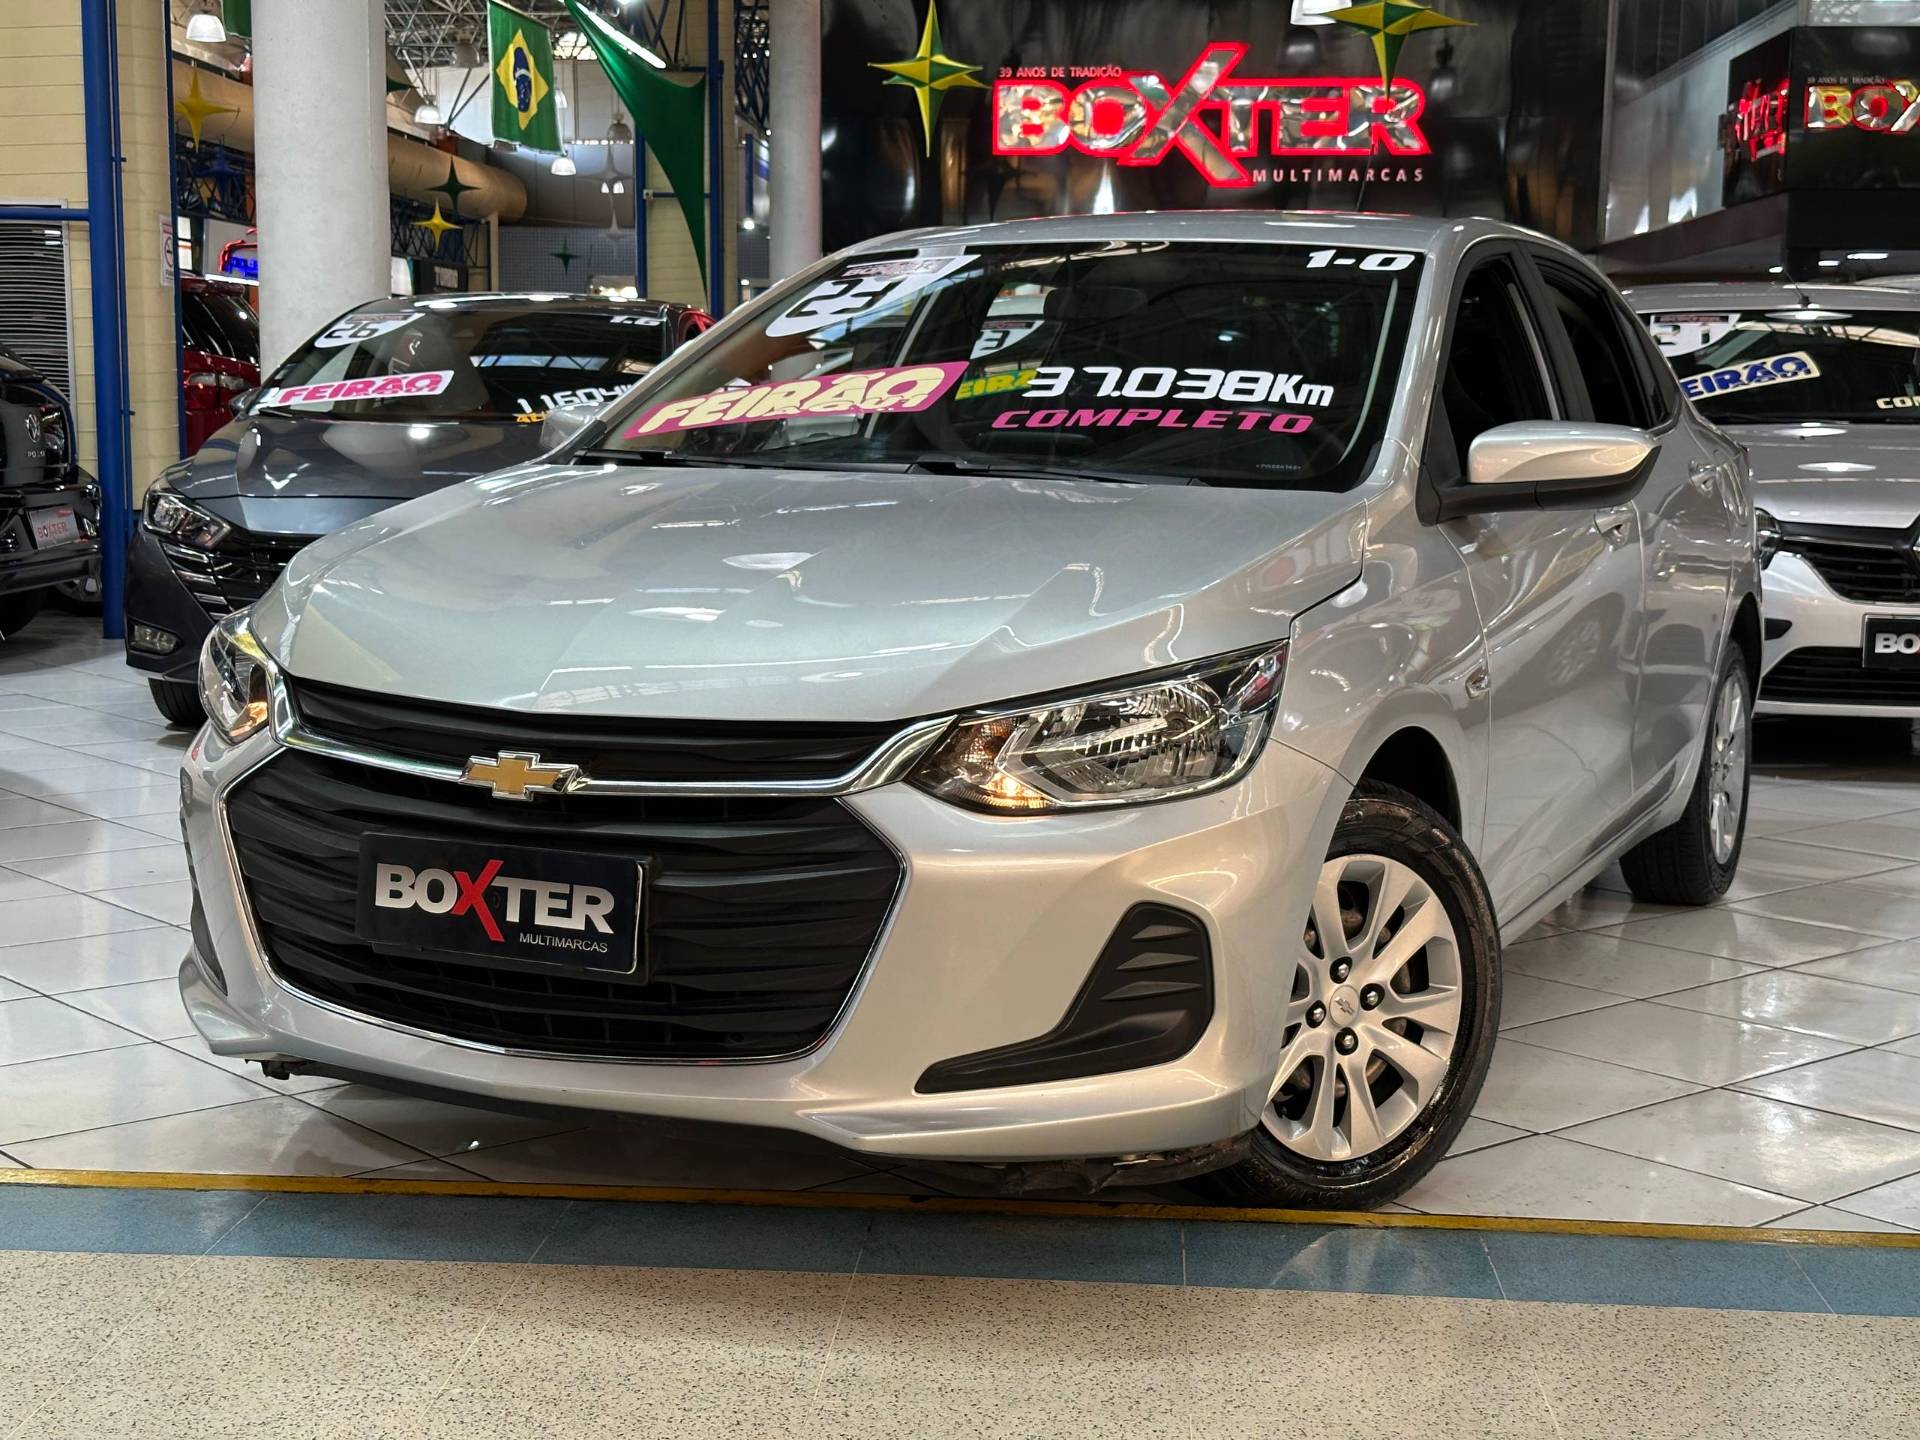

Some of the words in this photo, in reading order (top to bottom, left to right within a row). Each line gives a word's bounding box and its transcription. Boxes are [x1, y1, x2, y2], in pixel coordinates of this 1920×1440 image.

[999, 66, 1012, 78] 39
[1016, 66, 1047, 78] ANOS
[1051, 66, 1065, 78] DE
[1069, 63, 1122, 80] TRADIÇÃO
[993, 41, 1432, 188] BOXTER
[1252, 168, 1424, 183] MULTIMARCAS
[785, 277, 908, 319] 23
[324, 319, 379, 339] 26
[278, 373, 443, 404] FEIRÃO
[637, 366, 946, 434] FEIRÃO
[991, 408, 1314, 434] COMPLETO
[1874, 632, 1920, 655] BO
[375, 859, 615, 942] BOXTER
[519, 932, 609, 953] MULTIMARCAS
